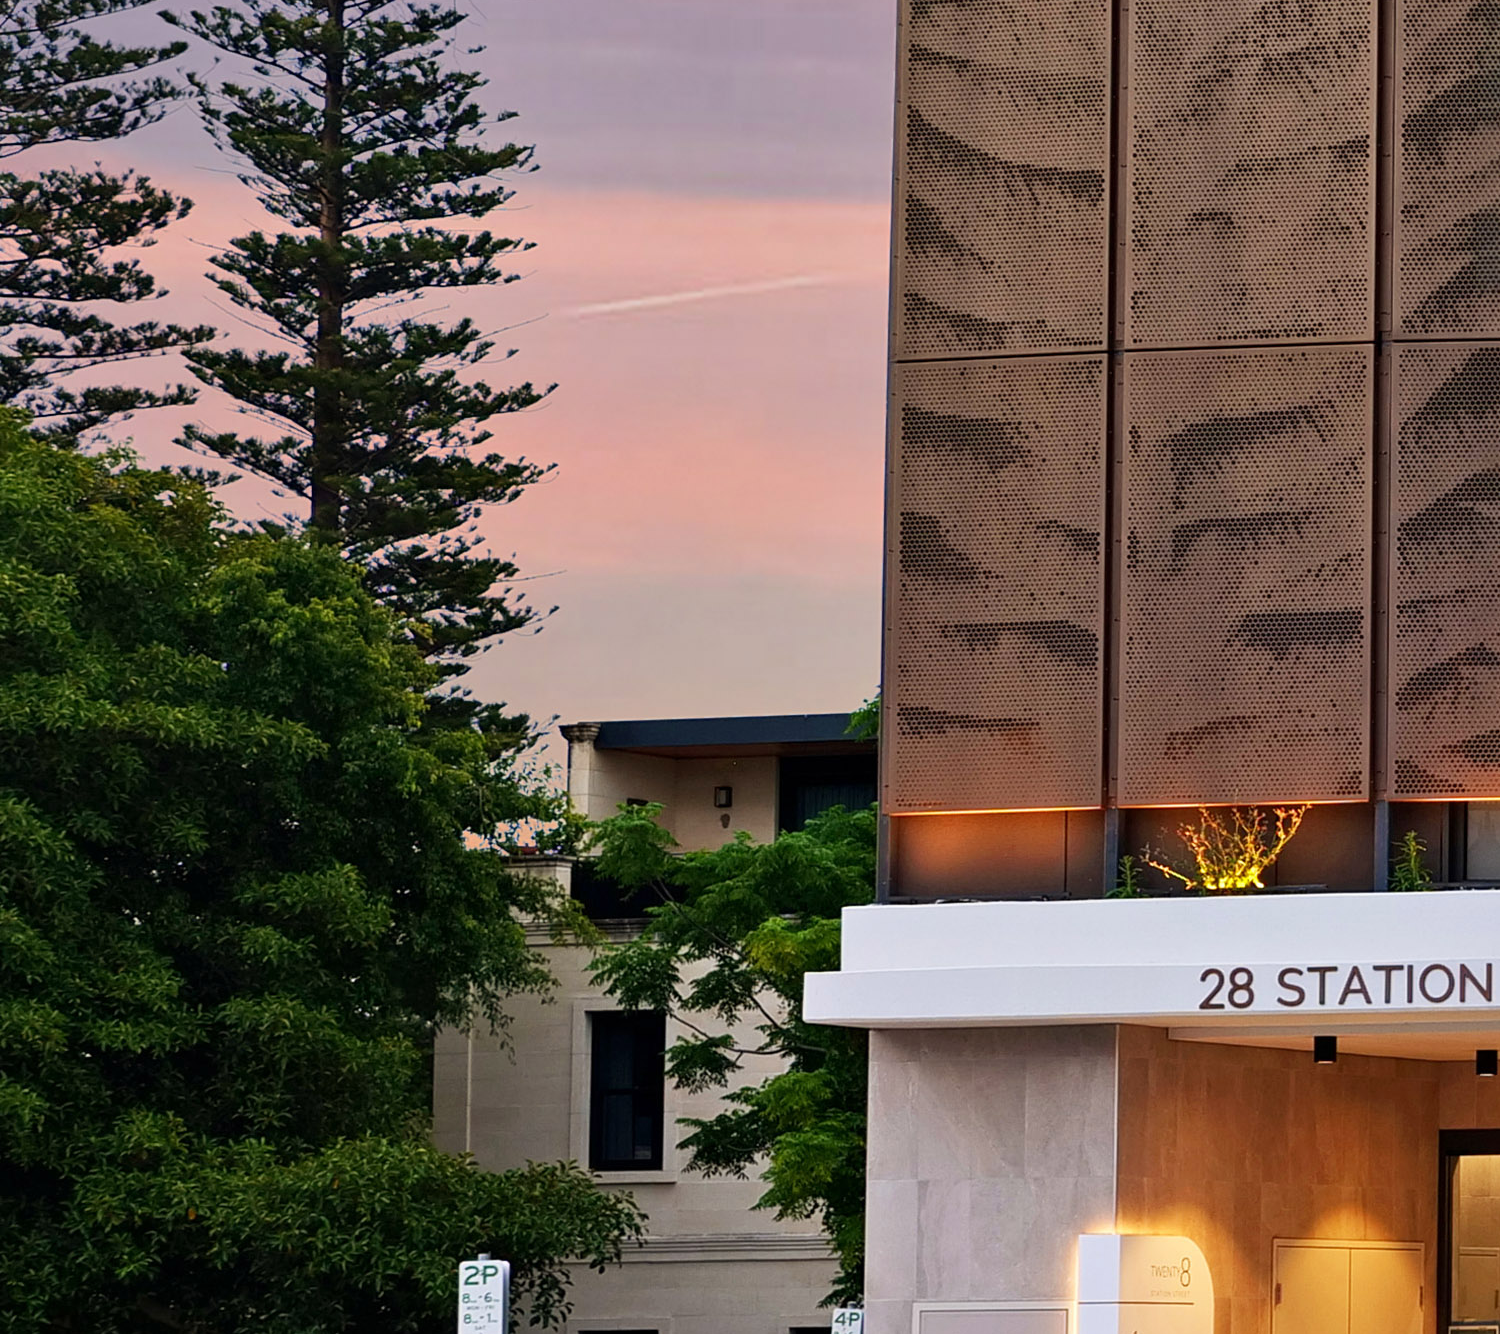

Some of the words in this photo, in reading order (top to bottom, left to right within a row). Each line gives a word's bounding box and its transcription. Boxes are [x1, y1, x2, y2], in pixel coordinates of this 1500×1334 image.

[1199, 967, 1254, 1009] 28
[1276, 962, 1492, 1007] STATION
[464, 1265, 498, 1285] 2P
[834, 1311, 860, 1327] 4P
